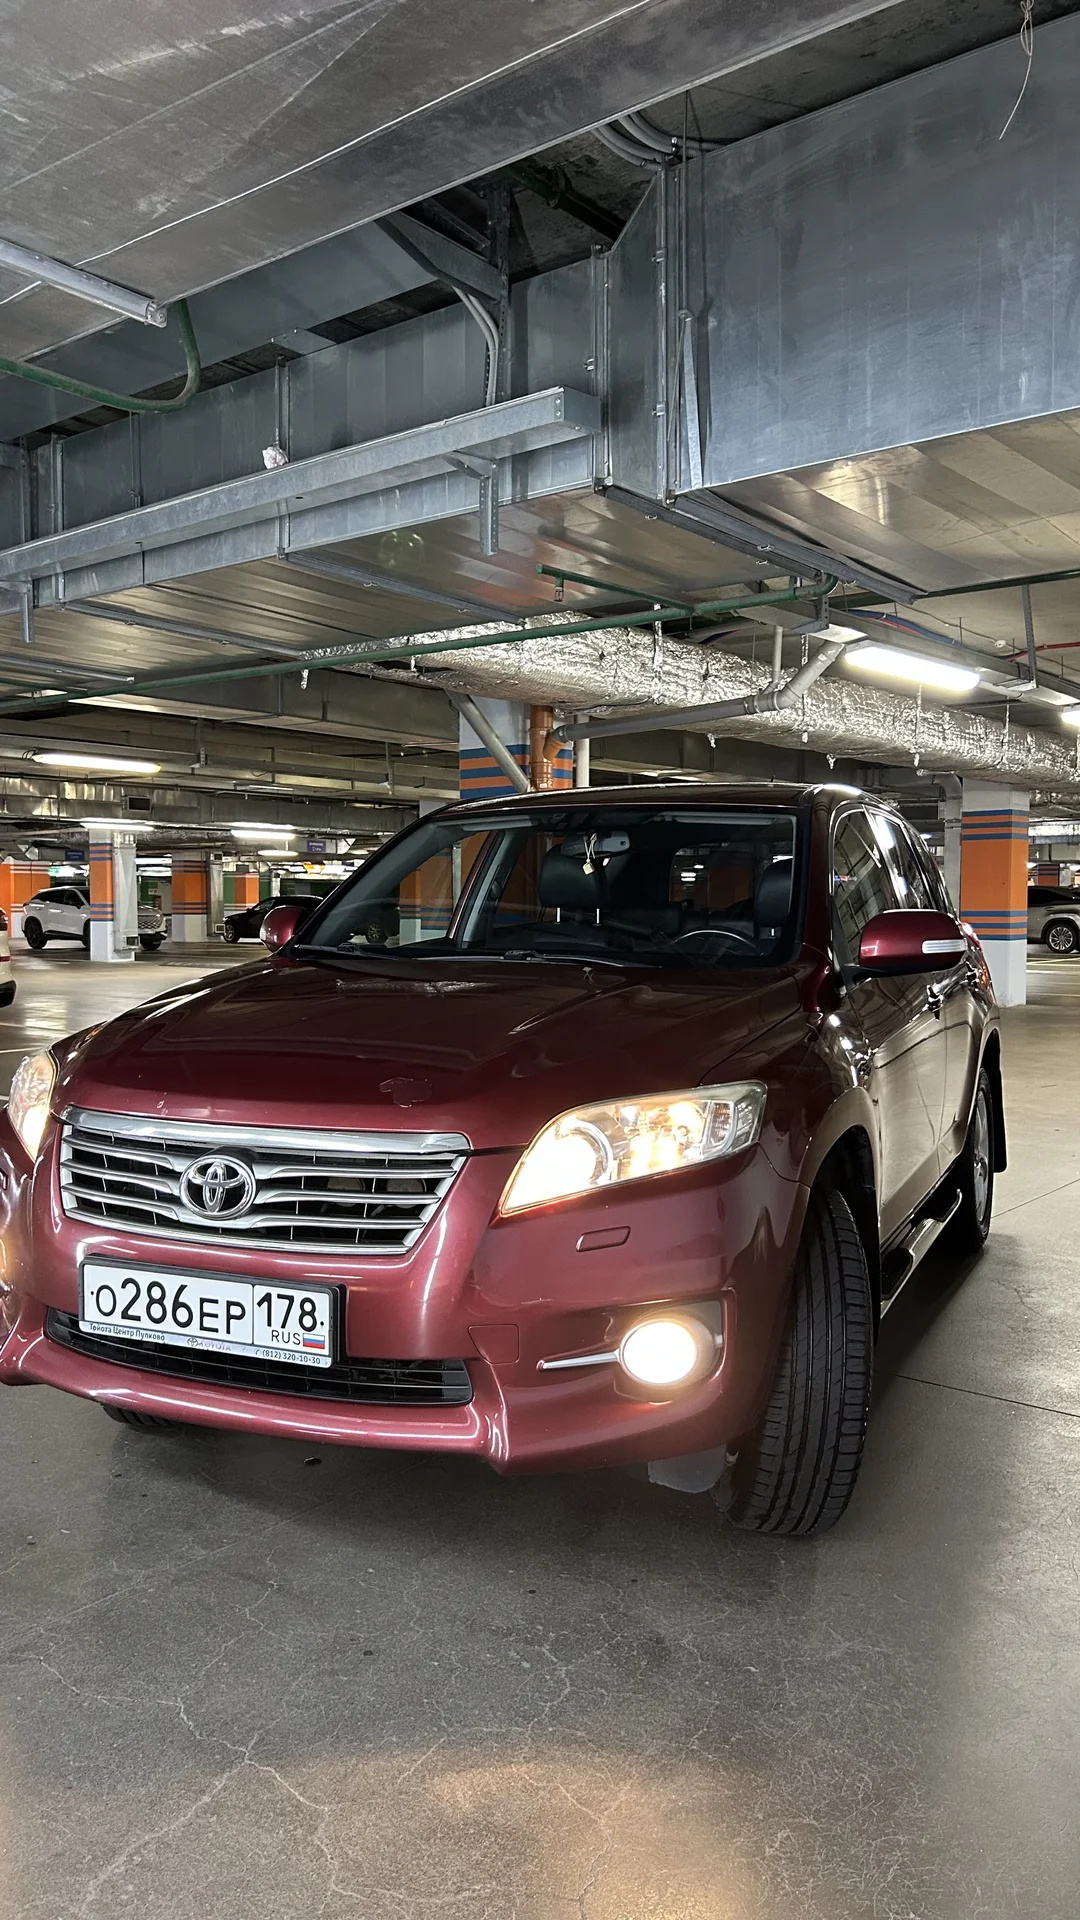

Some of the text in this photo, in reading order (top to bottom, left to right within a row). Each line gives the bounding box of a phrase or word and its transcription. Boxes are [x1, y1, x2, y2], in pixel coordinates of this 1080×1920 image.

[256, 1292, 317, 1332] 178
[89, 1323, 112, 1333] Тойота
[113, 1326, 134, 1338] Центр
[271, 1329, 301, 1345] RUS
[262, 1349, 281, 1360] (812)
